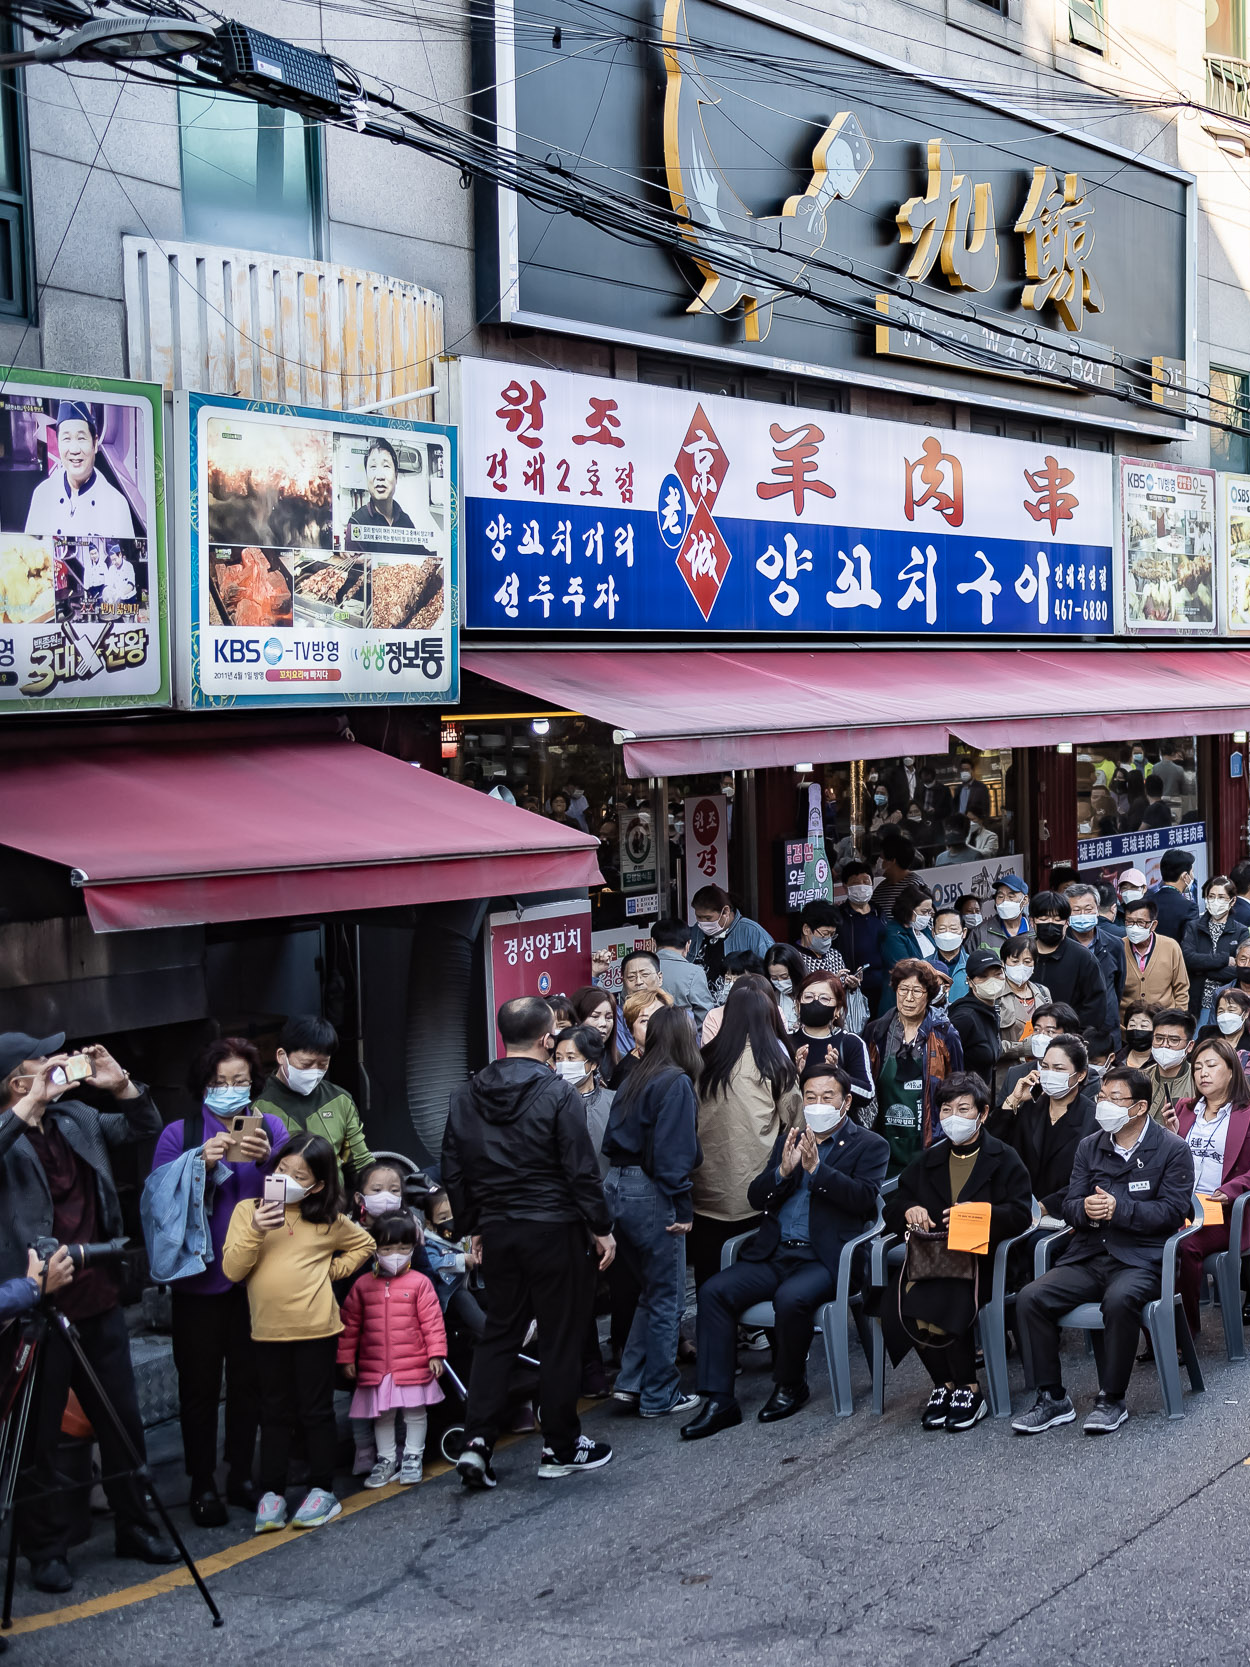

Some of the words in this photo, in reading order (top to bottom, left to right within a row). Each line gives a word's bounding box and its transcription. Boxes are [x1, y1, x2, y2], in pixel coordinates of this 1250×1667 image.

[496, 380, 625, 448] 원조
[486, 448, 634, 503] 건대2호점
[757, 423, 1080, 536] 羊肉串
[1127, 472, 1146, 489] KBS
[1237, 488, 1250, 503] SBS
[486, 513, 635, 568] 양꼬치거리
[756, 533, 1051, 625] 양꼬치구이
[1054, 563, 1108, 592] 건대직영점
[494, 572, 620, 620] 선두주자
[1054, 599, 1108, 622] 467-6880
[214, 639, 261, 663] KBS
[214, 671, 233, 680] 2011년
[693, 810, 718, 834] 원조
[1121, 833, 1160, 854] 京城羊肉串
[1169, 825, 1204, 847] 京城羊肉串
[1078, 839, 1112, 860] 城羊肉串
[788, 869, 806, 886] 오늘
[788, 887, 829, 907] 뭐먹을까?
[942, 881, 963, 903] SBS
[503, 928, 582, 966] 경성양꼬치
